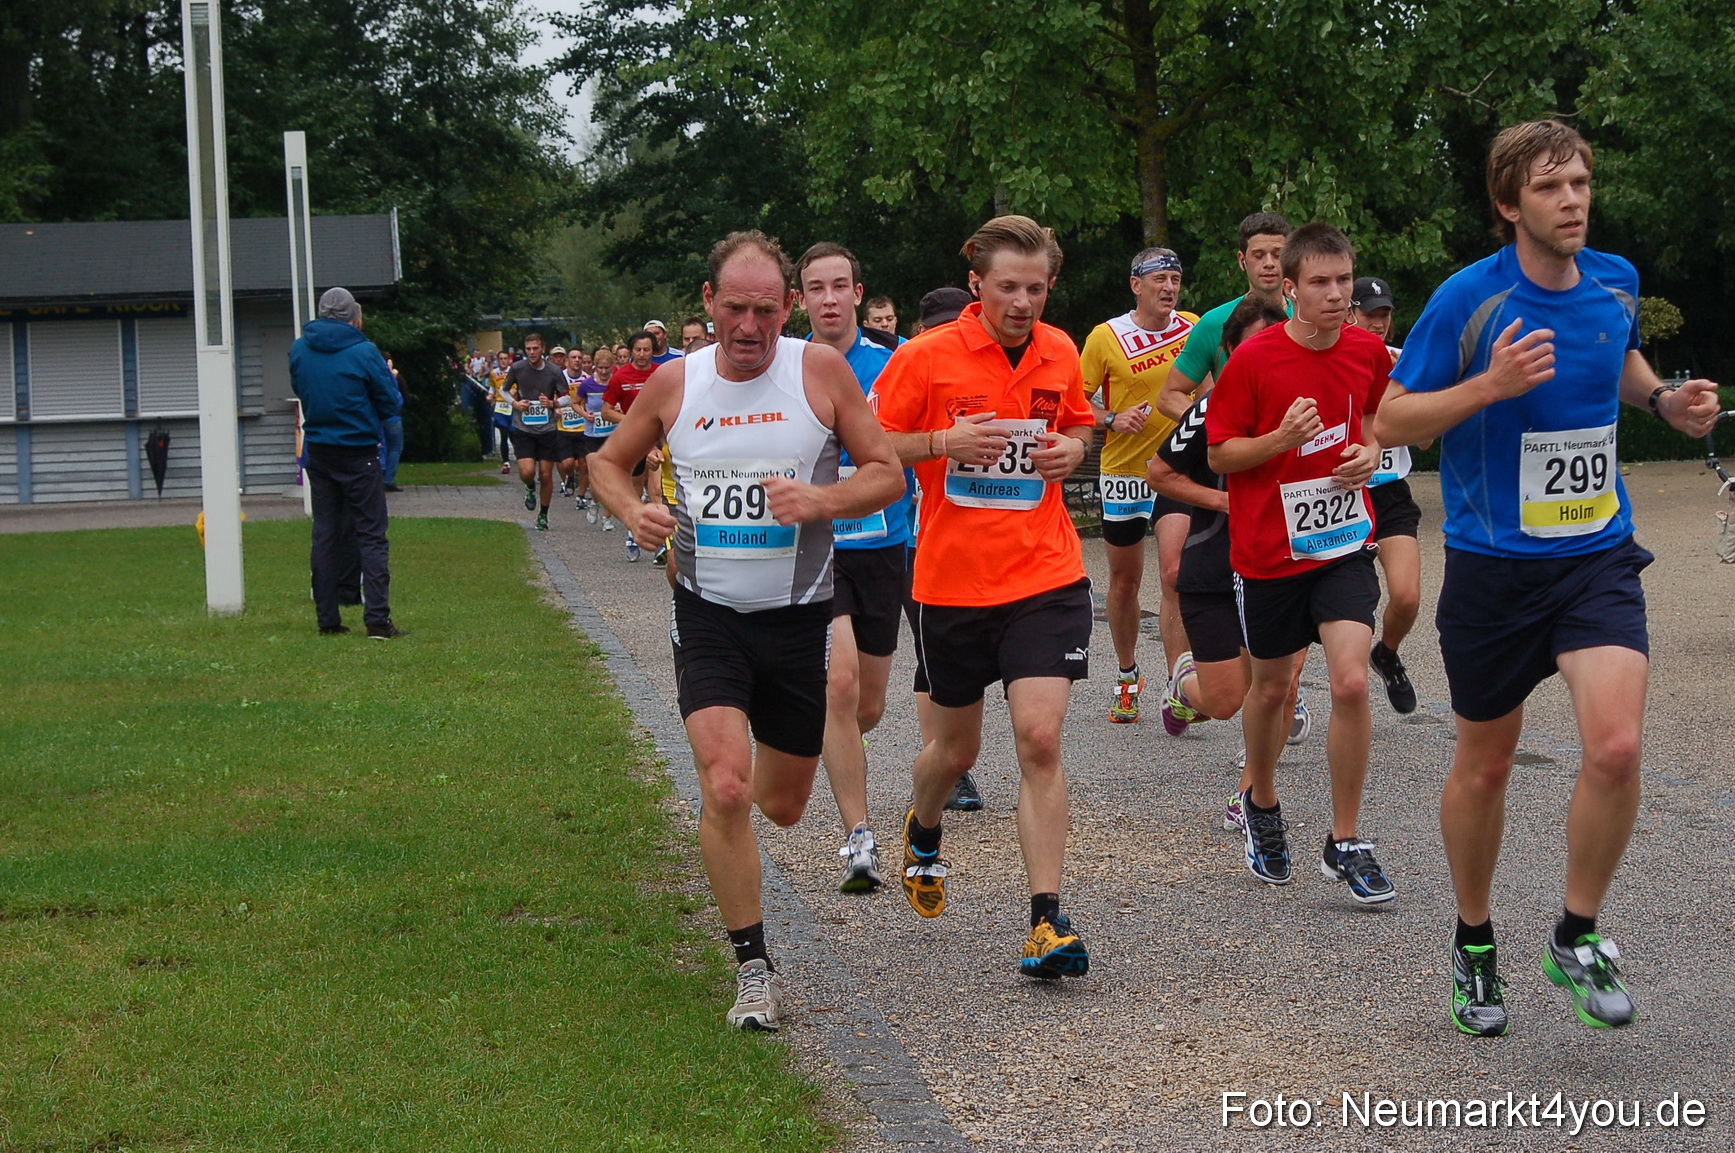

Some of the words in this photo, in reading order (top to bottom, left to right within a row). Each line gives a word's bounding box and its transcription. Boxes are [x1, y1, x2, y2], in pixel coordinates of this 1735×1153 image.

[1130, 352, 1168, 375] MAX
[720, 411, 789, 427] KLEBL
[1314, 433, 1335, 447] DEHN
[1523, 443, 1561, 453] PARTL
[1376, 450, 1393, 470] 5
[693, 470, 729, 479] PARTL
[731, 469, 780, 479] Neumarkt
[1544, 452, 1608, 495] 299
[968, 481, 1021, 497] Andreas
[1104, 480, 1151, 500] 2900
[1283, 489, 1314, 500] PARTL
[1316, 484, 1342, 496] Neuma
[702, 484, 776, 520] 269
[1294, 490, 1359, 532] 2322
[1560, 504, 1594, 521] Holm
[832, 520, 862, 532] udwig
[719, 530, 767, 545] Roland
[1306, 529, 1358, 551] Alexander
